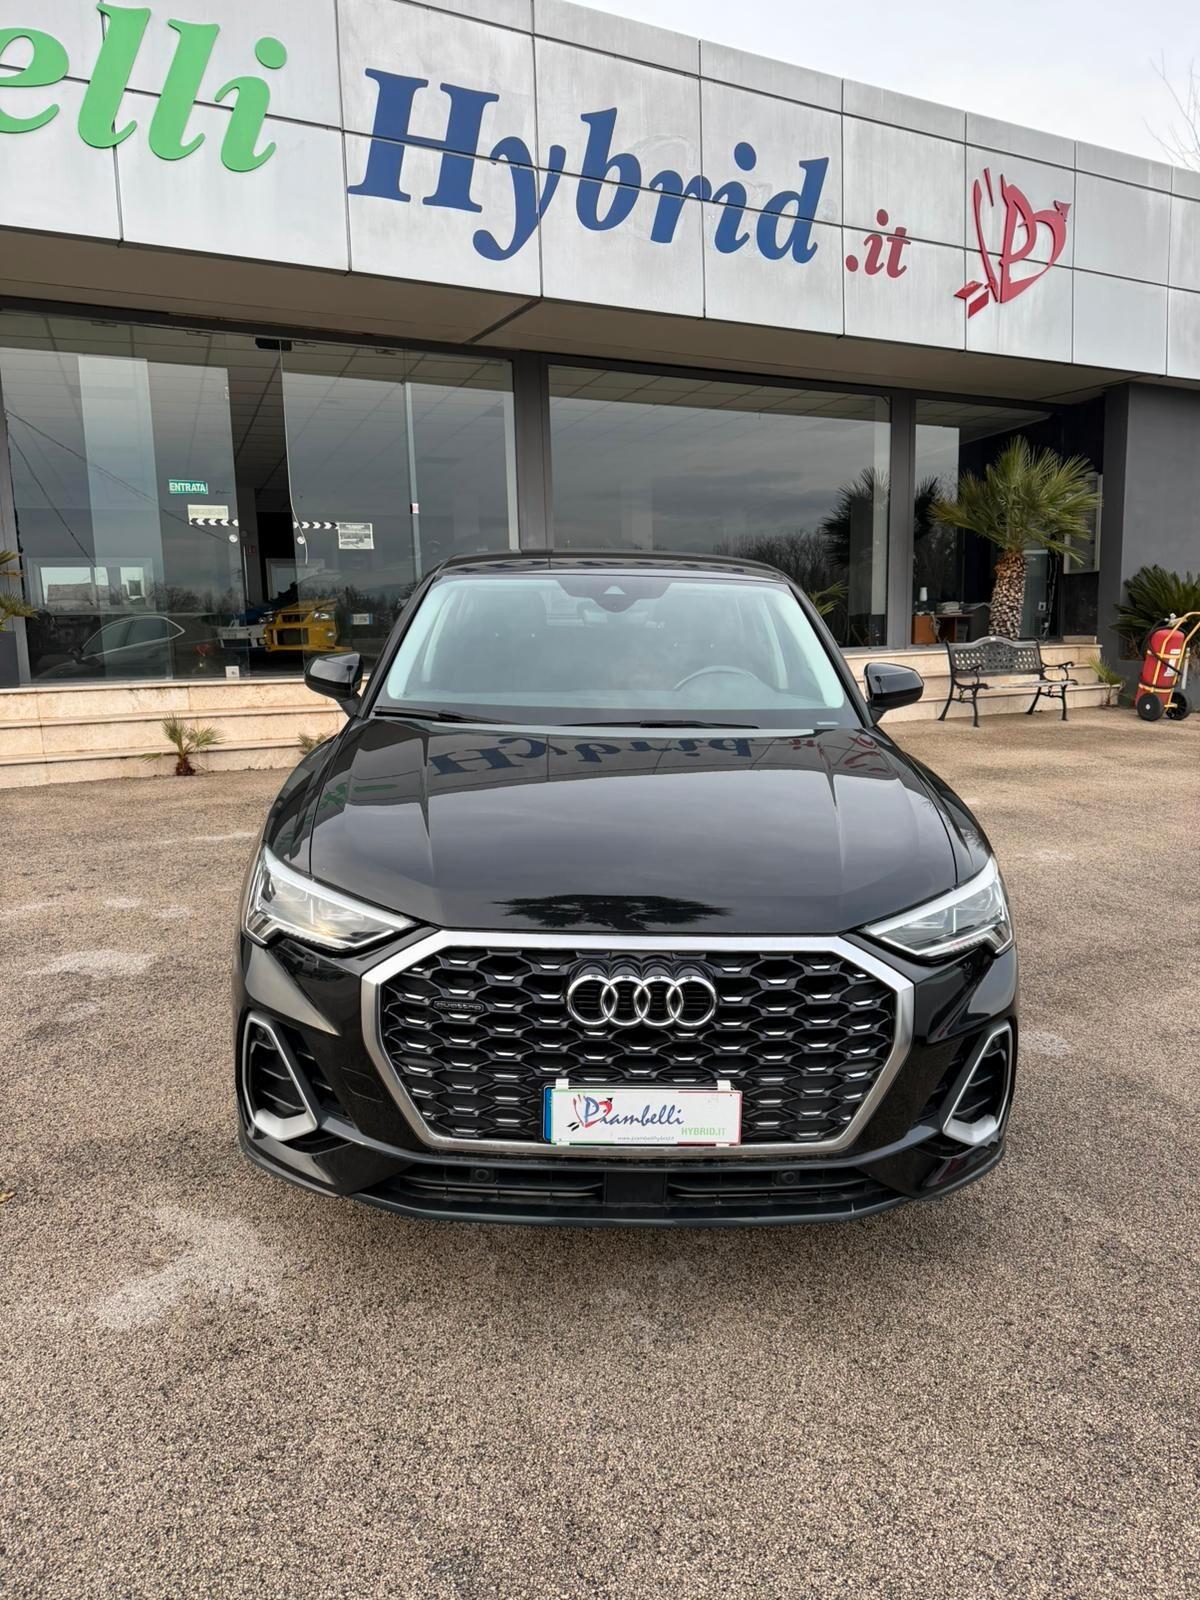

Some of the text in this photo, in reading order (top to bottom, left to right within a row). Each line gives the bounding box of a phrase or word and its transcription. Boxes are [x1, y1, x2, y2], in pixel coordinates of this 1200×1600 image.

[347, 69, 829, 264] Hybrid
[168, 481, 206, 492] ENTRATA
[583, 1095, 684, 1127] Piambelli
[681, 1127, 727, 1137] HYBRID.IT
